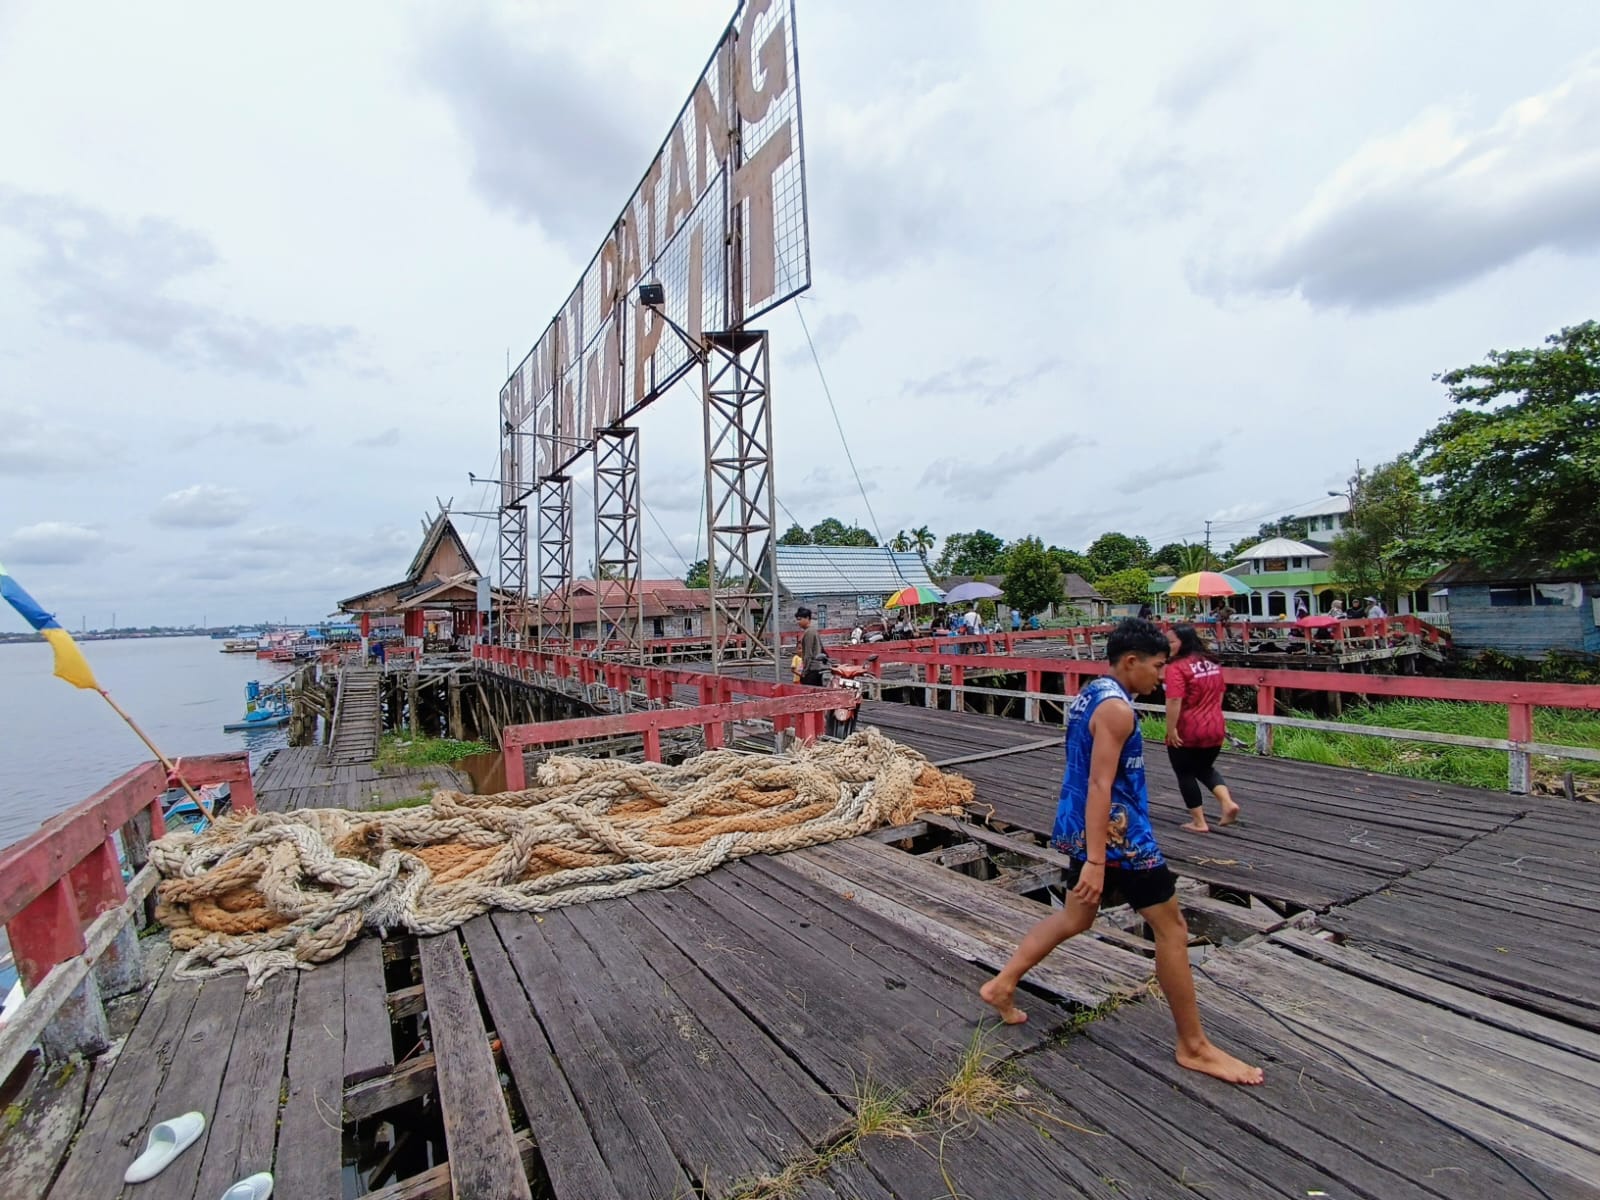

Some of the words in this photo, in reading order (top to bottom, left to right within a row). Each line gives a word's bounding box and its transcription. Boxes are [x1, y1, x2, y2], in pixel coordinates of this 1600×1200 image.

[502, 283, 583, 438] SELAMAT
[600, 0, 788, 323] DATANG
[537, 117, 792, 478] SAMPIT
